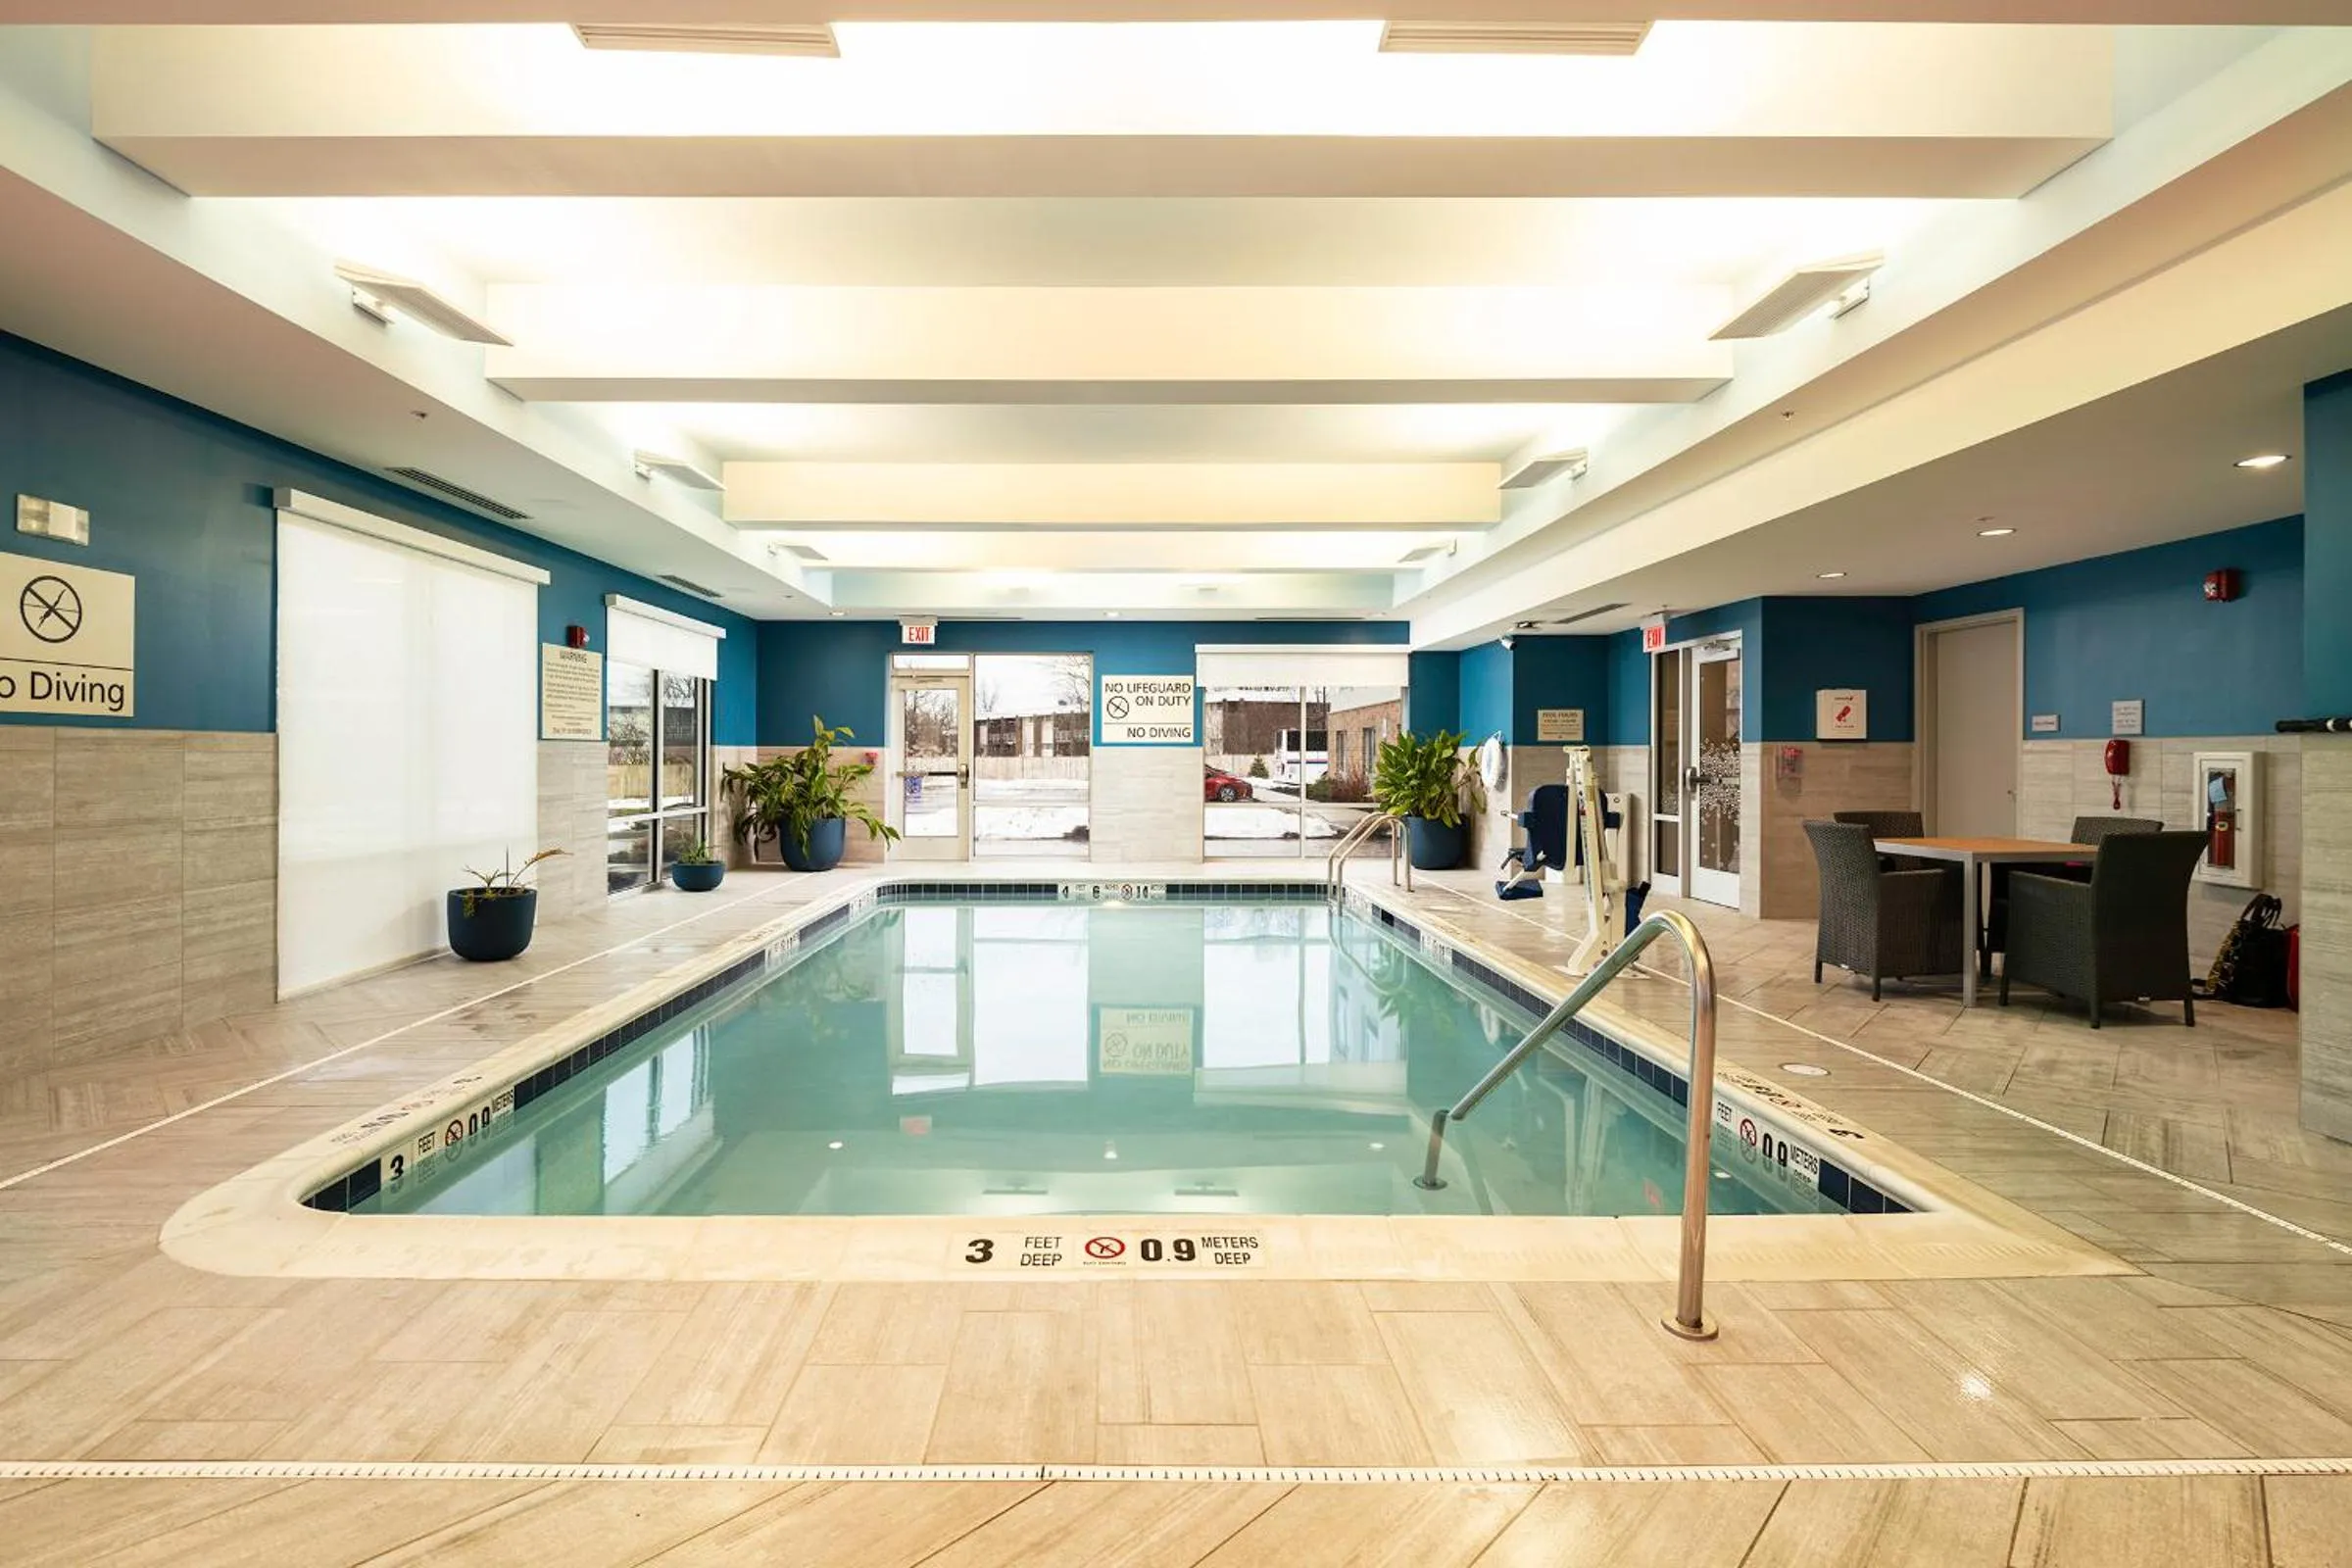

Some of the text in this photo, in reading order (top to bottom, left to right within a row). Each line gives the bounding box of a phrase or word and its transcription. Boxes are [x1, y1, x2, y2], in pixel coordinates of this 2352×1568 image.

[908, 626, 930, 642] EXIT
[0, 670, 124, 711] o Diving
[1104, 682, 1192, 694] NO LIFEGUARD
[1135, 696, 1192, 707] ON DUTY
[1127, 727, 1192, 738] NO DIVING
[417, 1131, 436, 1155] FEET
[1789, 1144, 1818, 1175] METERS
[390, 1154, 404, 1181] 3
[1025, 1237, 1062, 1249] FEET
[1201, 1237, 1258, 1249] METERS
[965, 1239, 994, 1263] 3
[1141, 1239, 1196, 1262] 0.9
[1020, 1253, 1062, 1266] DEEP
[1214, 1252, 1250, 1264] DEEP
